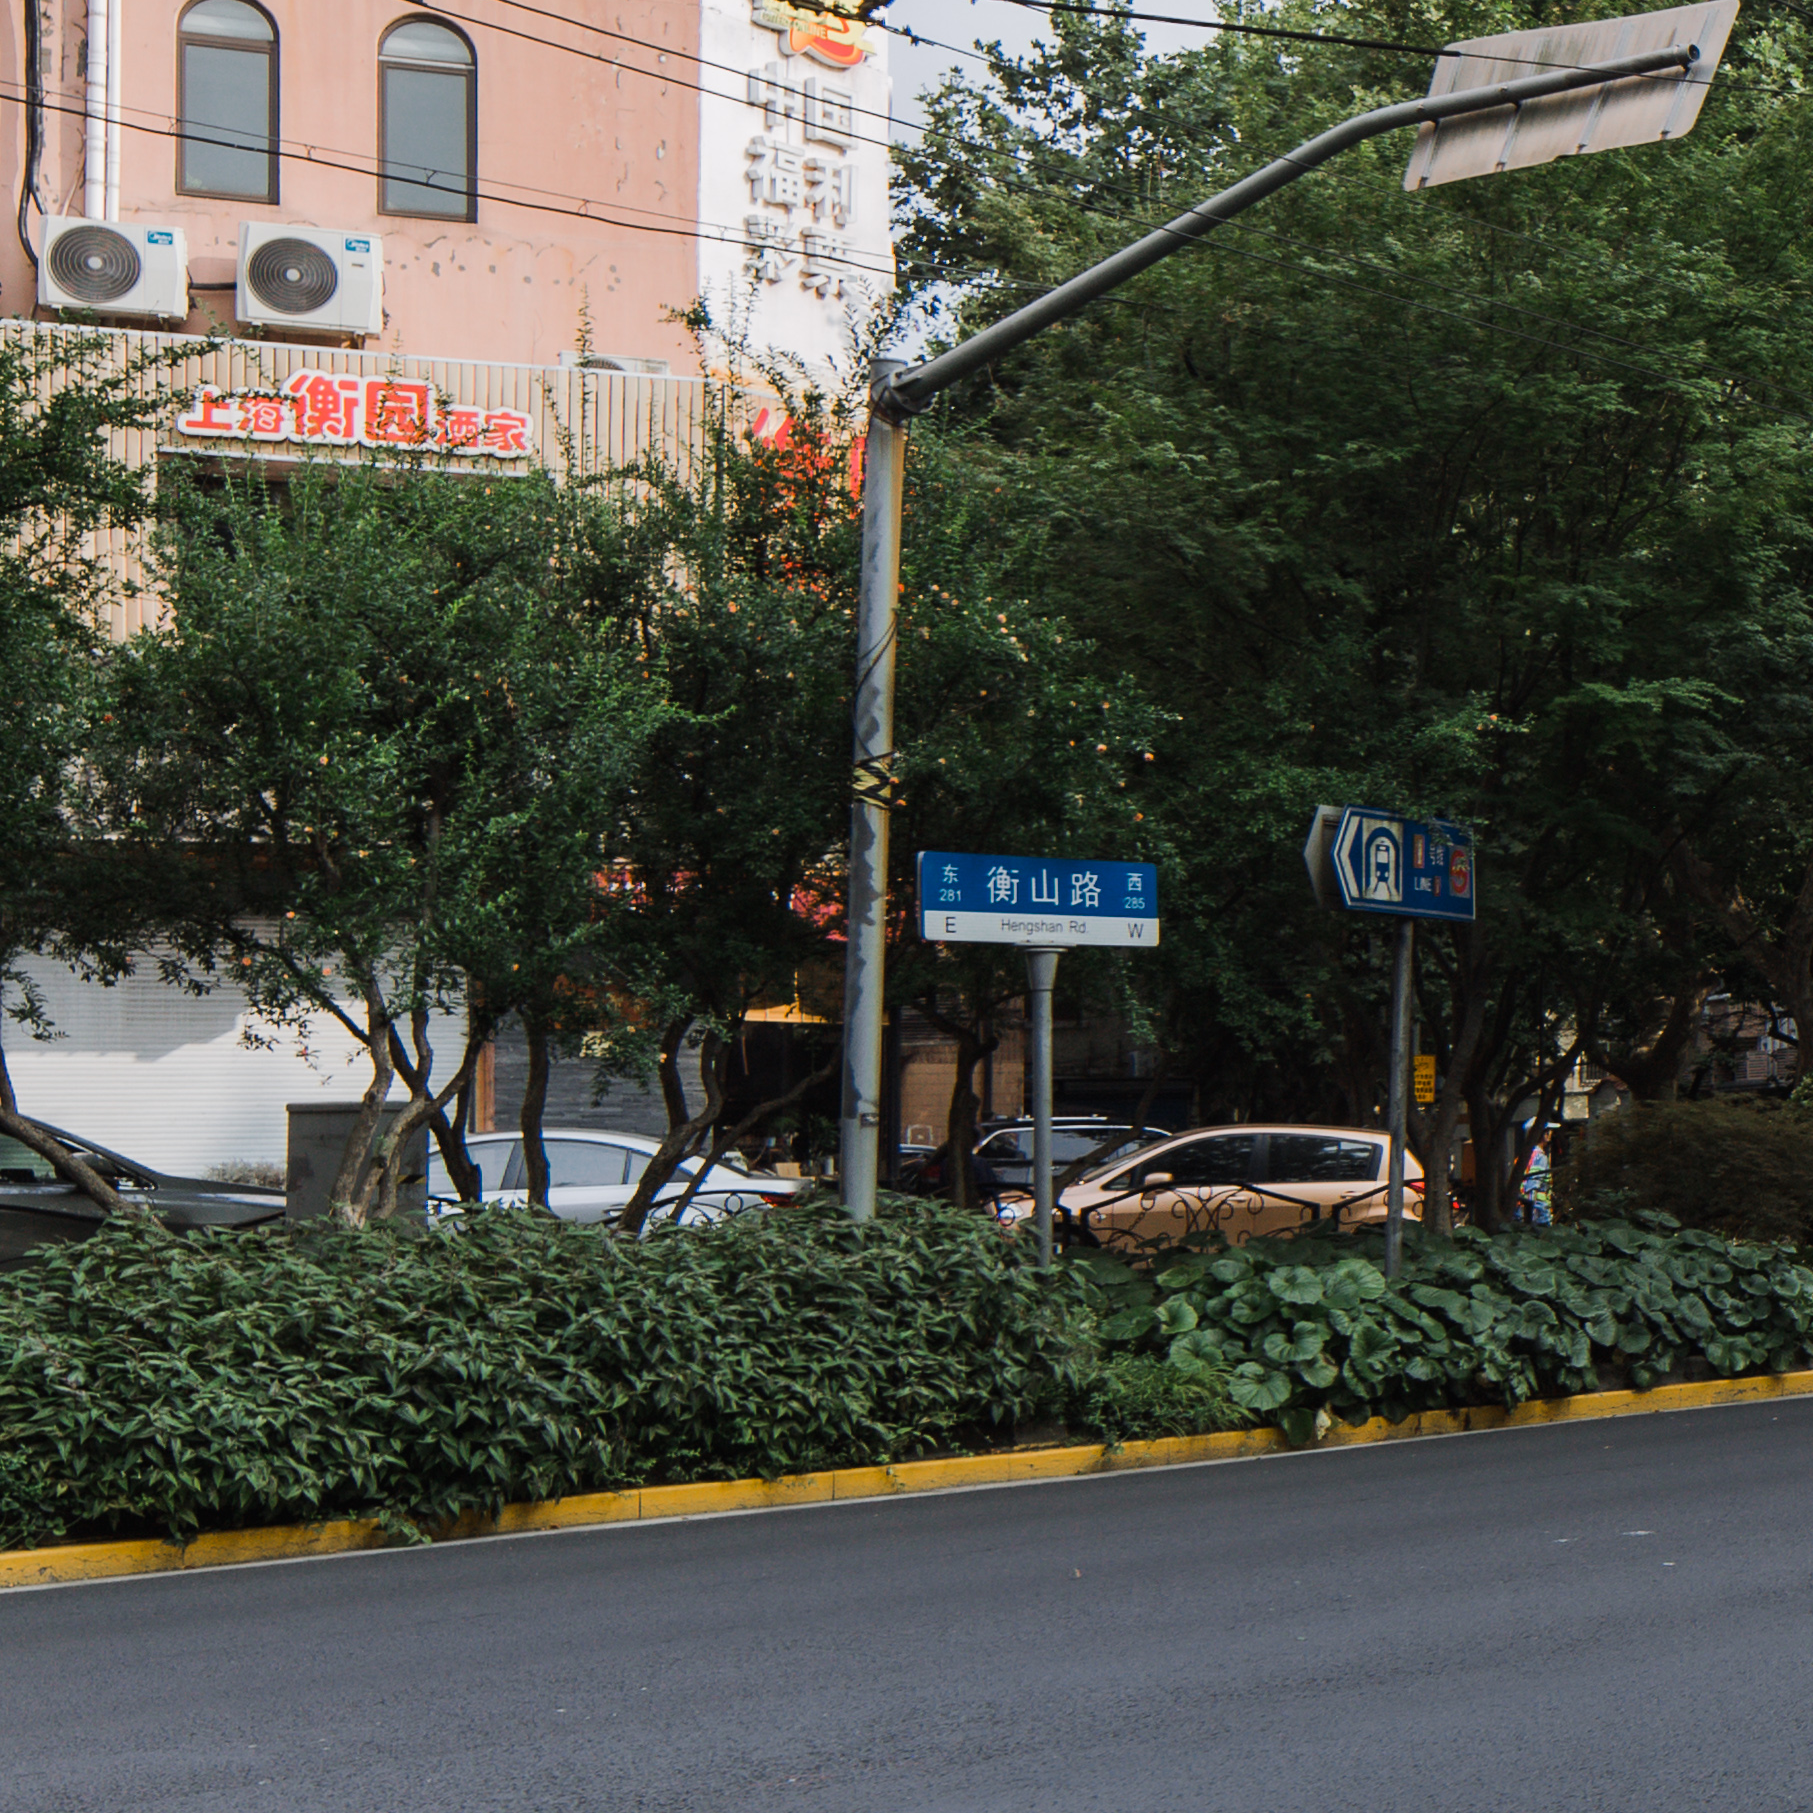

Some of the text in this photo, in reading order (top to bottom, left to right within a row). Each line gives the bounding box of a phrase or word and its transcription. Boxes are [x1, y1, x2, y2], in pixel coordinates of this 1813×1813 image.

[748, 61, 858, 154] 中国
[745, 136, 858, 228] 福利
[939, 888, 1146, 910] 281 285
[941, 863, 1144, 909] 东 衡山路 西
[944, 916, 957, 934] E
[1001, 919, 1063, 936] Hengshan
[1127, 923, 1144, 939] W
